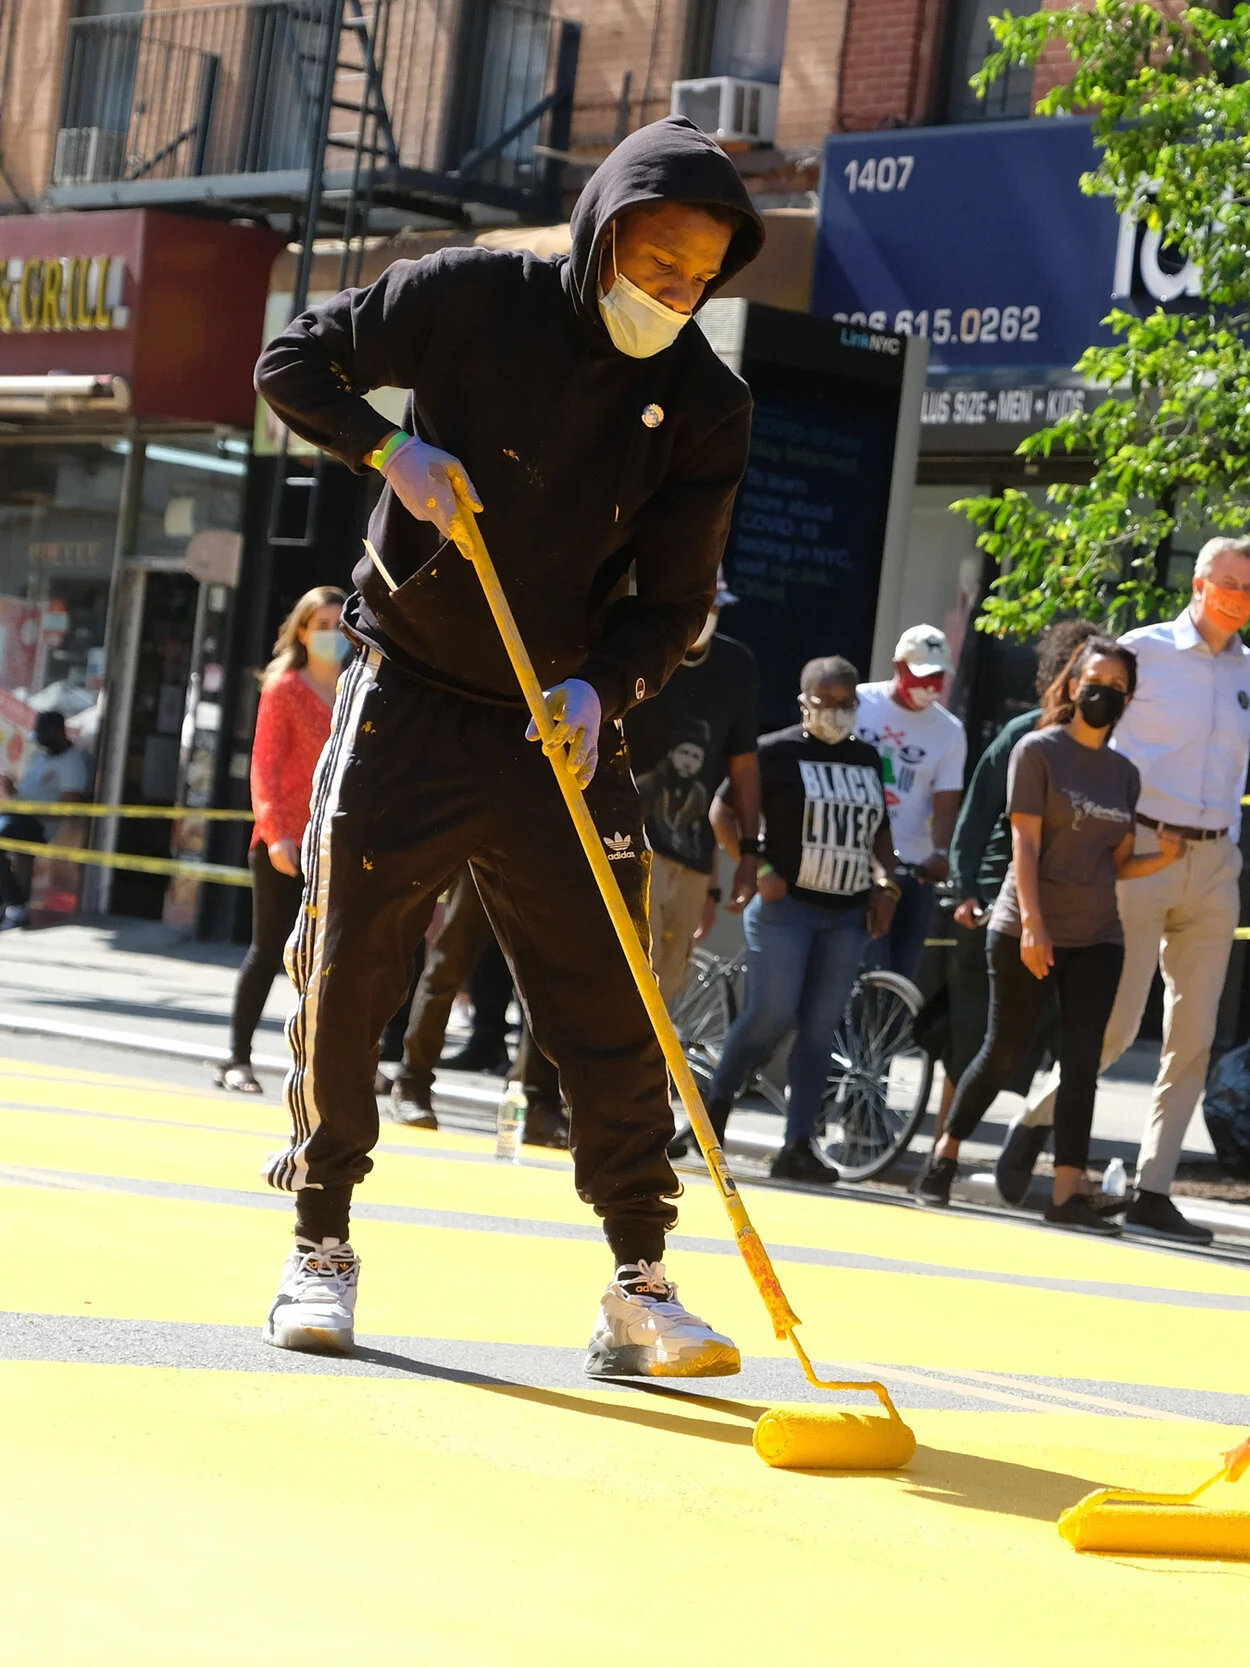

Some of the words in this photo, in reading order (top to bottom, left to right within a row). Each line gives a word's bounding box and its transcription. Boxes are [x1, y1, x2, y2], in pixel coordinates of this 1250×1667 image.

[844, 155, 915, 194] 1407
[20, 255, 111, 333] GRILL
[840, 327, 900, 356] LinkNYC
[953, 390, 987, 425] SIZE
[798, 761, 883, 807] BLACK
[607, 851, 635, 861] adidas
